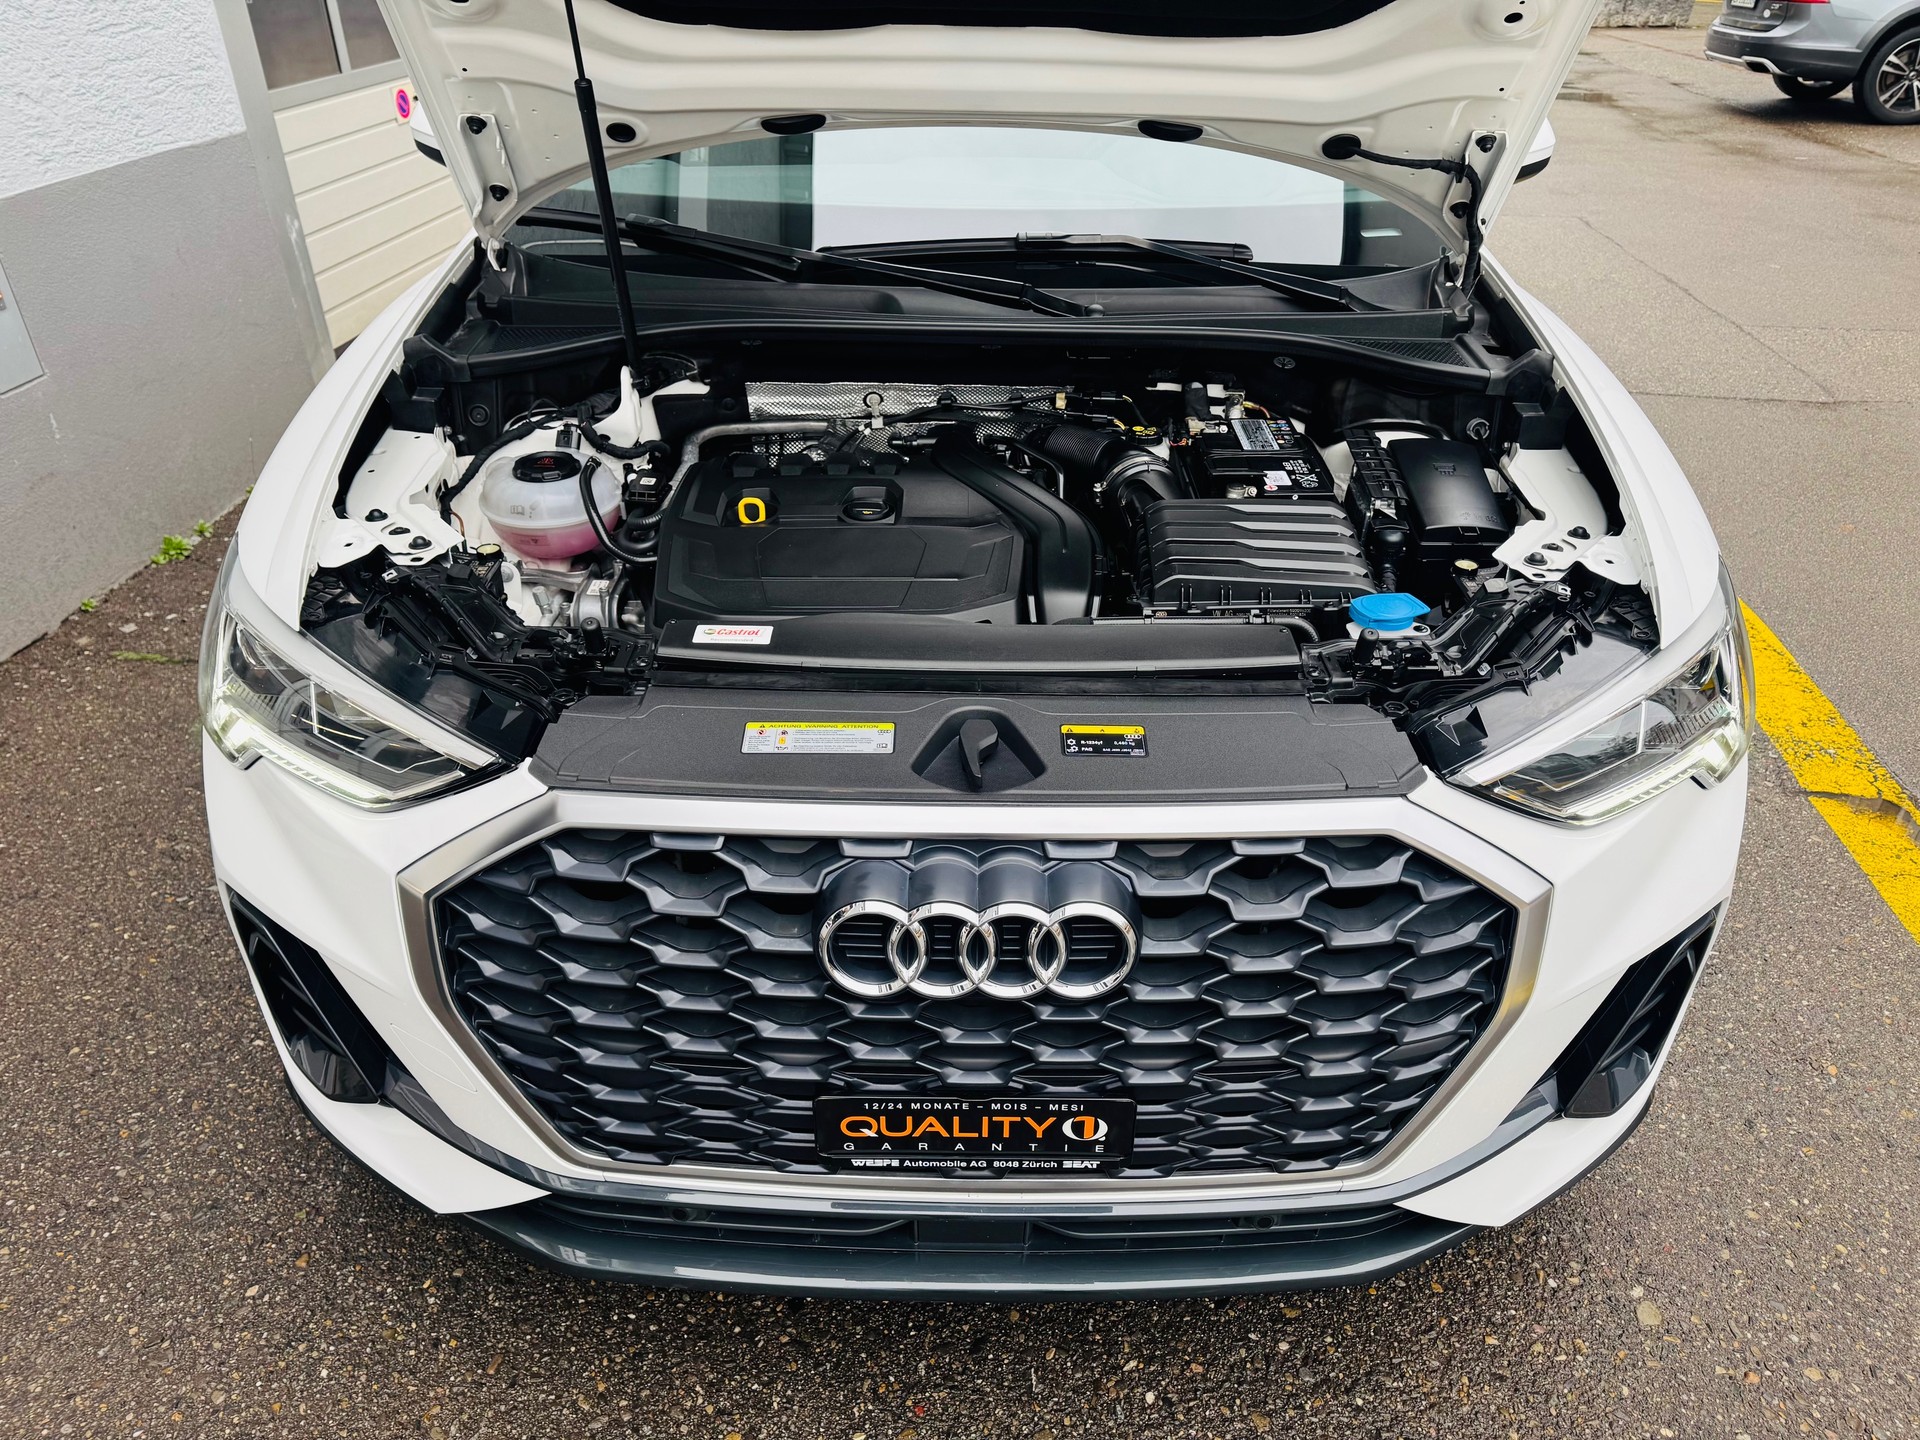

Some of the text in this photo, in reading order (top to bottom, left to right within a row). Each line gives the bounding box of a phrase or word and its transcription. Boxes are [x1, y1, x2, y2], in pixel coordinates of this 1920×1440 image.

[717, 628, 761, 636] Castrol
[991, 1103, 1028, 1111] MOIS
[840, 1115, 1057, 1138] QUALITY
[843, 1142, 1105, 1153] GARANTIE
[969, 1160, 987, 1168] AG
[993, 1160, 1019, 1168] 8048
[1022, 1160, 1057, 1168] Zürich
[1062, 1160, 1100, 1168] SEAT
